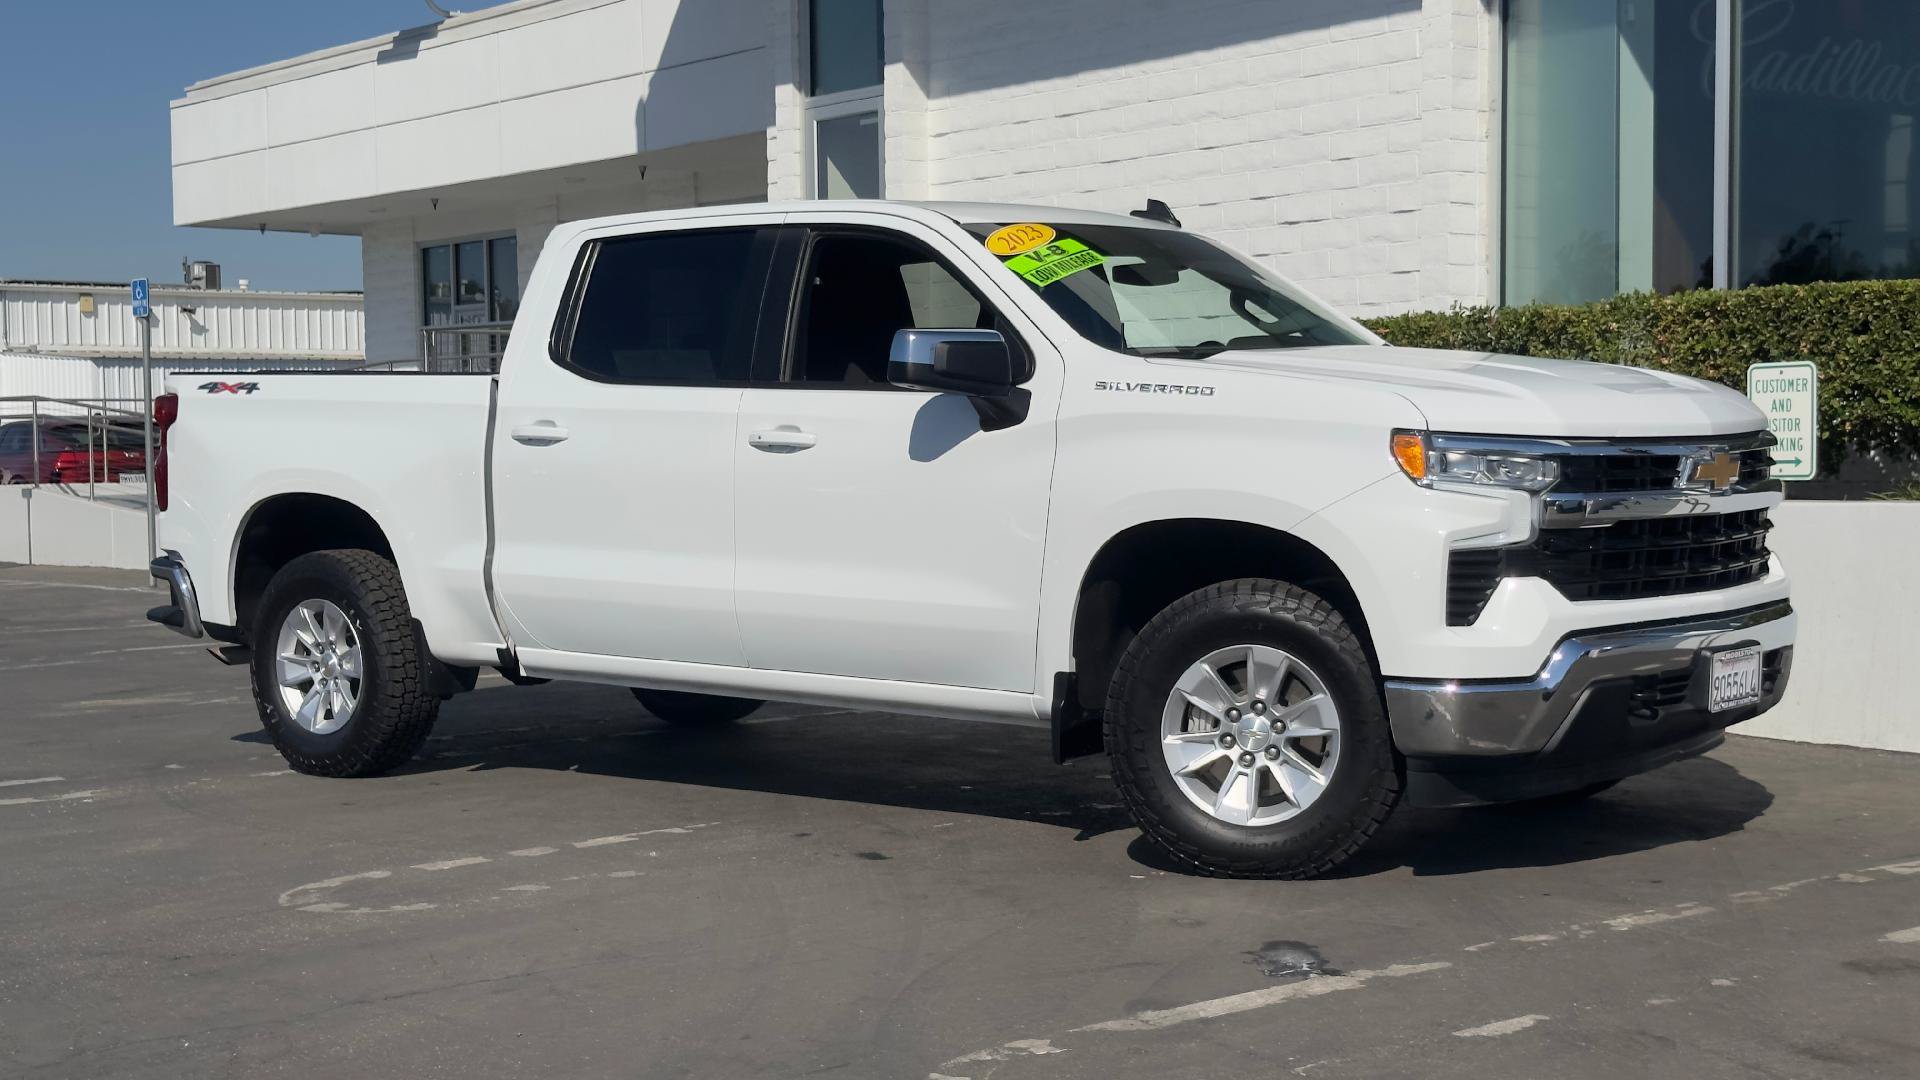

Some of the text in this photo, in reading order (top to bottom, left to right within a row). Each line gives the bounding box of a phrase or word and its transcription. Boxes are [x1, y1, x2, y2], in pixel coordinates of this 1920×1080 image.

[1689, 0, 1920, 104] Cadillac
[997, 226, 1044, 251] 2023
[1024, 245, 1067, 263] V-8
[1029, 252, 1101, 283] LOW MILEAGE
[1094, 381, 1216, 396] SILVERADO
[1755, 378, 1808, 393] CUSTOMER
[1771, 399, 1792, 413] AND
[1768, 418, 1801, 432] ISITOR
[1770, 437, 1803, 451] KING
[1713, 669, 1757, 702] 90556L4
